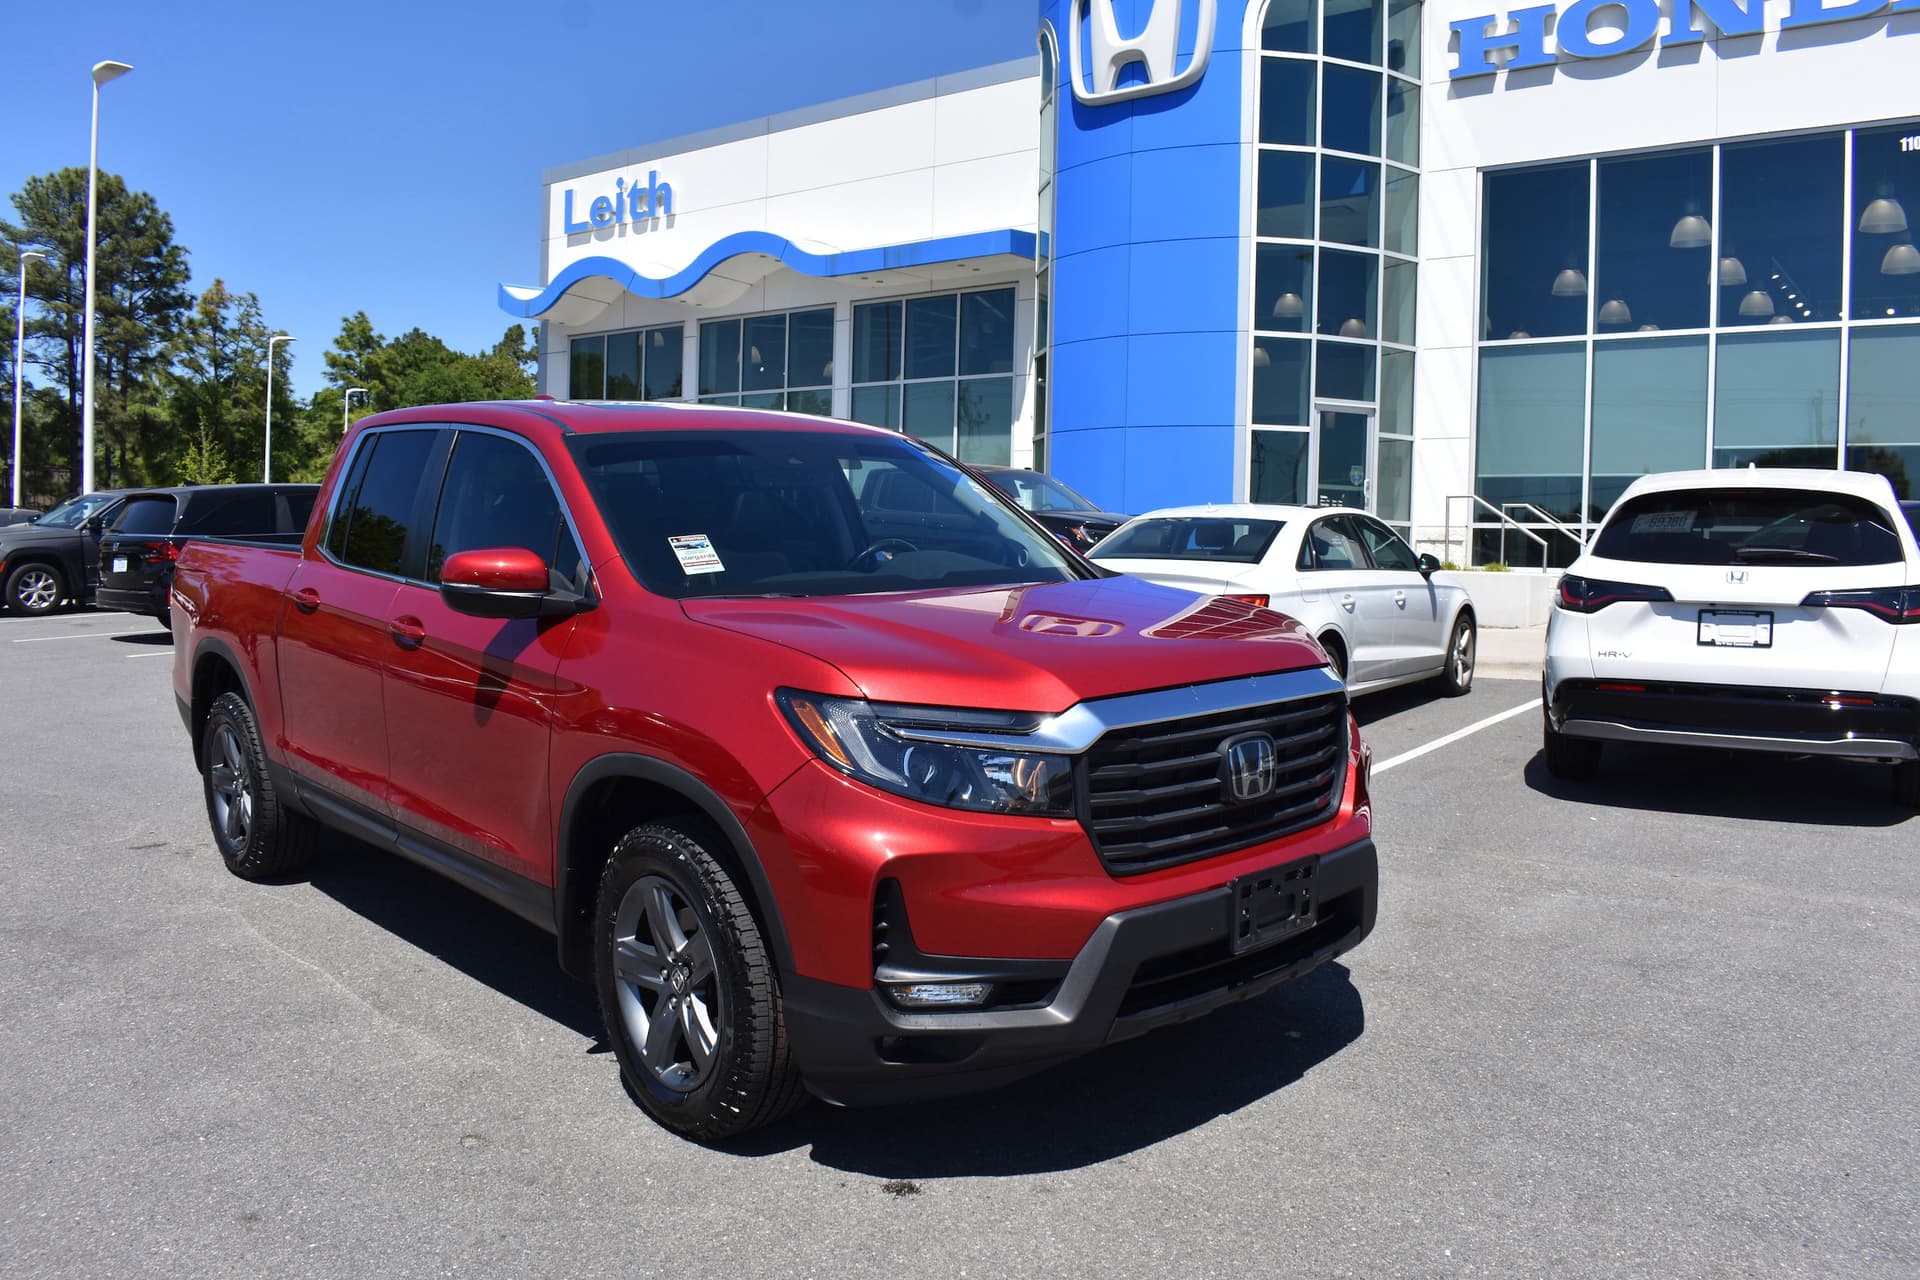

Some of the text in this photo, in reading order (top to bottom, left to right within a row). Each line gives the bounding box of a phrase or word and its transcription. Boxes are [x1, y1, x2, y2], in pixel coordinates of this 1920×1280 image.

[1449, 0, 1920, 79] HON
[564, 170, 672, 235] Leith
[1598, 650, 1632, 658] HR-V
